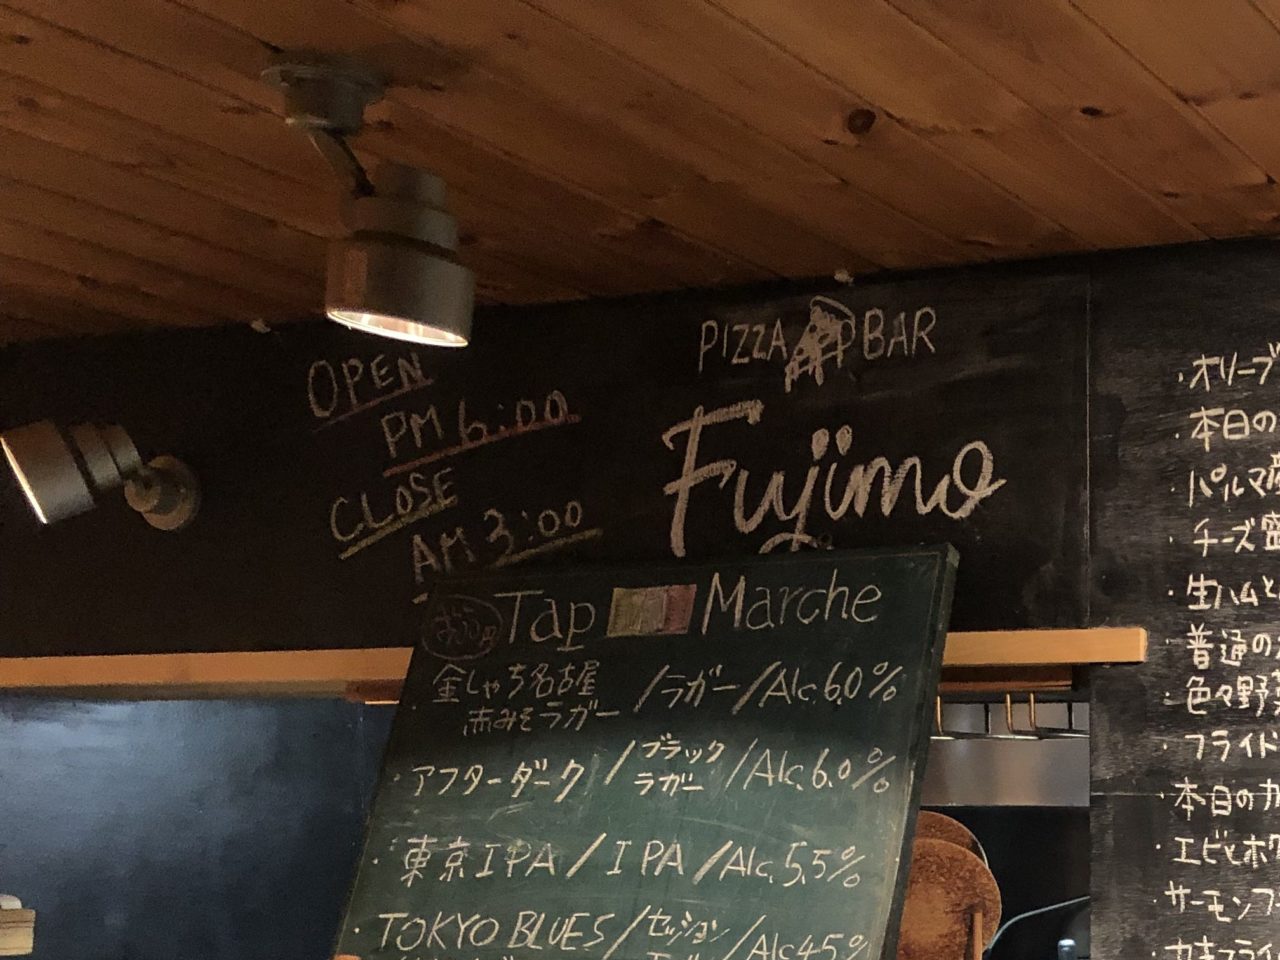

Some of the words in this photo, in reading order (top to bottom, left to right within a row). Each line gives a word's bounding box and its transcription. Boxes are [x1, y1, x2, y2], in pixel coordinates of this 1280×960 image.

[698, 319, 788, 374] PIZZA
[864, 307, 936, 361] BAR
[307, 352, 424, 418] OPEN
[380, 404, 444, 458] PM
[459, 390, 569, 444] 6:00
[330, 467, 458, 541] CLOSE
[662, 399, 1007, 558] Fujimo
[411, 526, 476, 584] AM
[484, 500, 583, 555] 3:00
[494, 588, 596, 651] Tap
[702, 569, 882, 636] Marche
[411, 758, 585, 804] アフターダーク
[377, 910, 501, 952] TOKYO
[507, 909, 616, 951] BLUES
